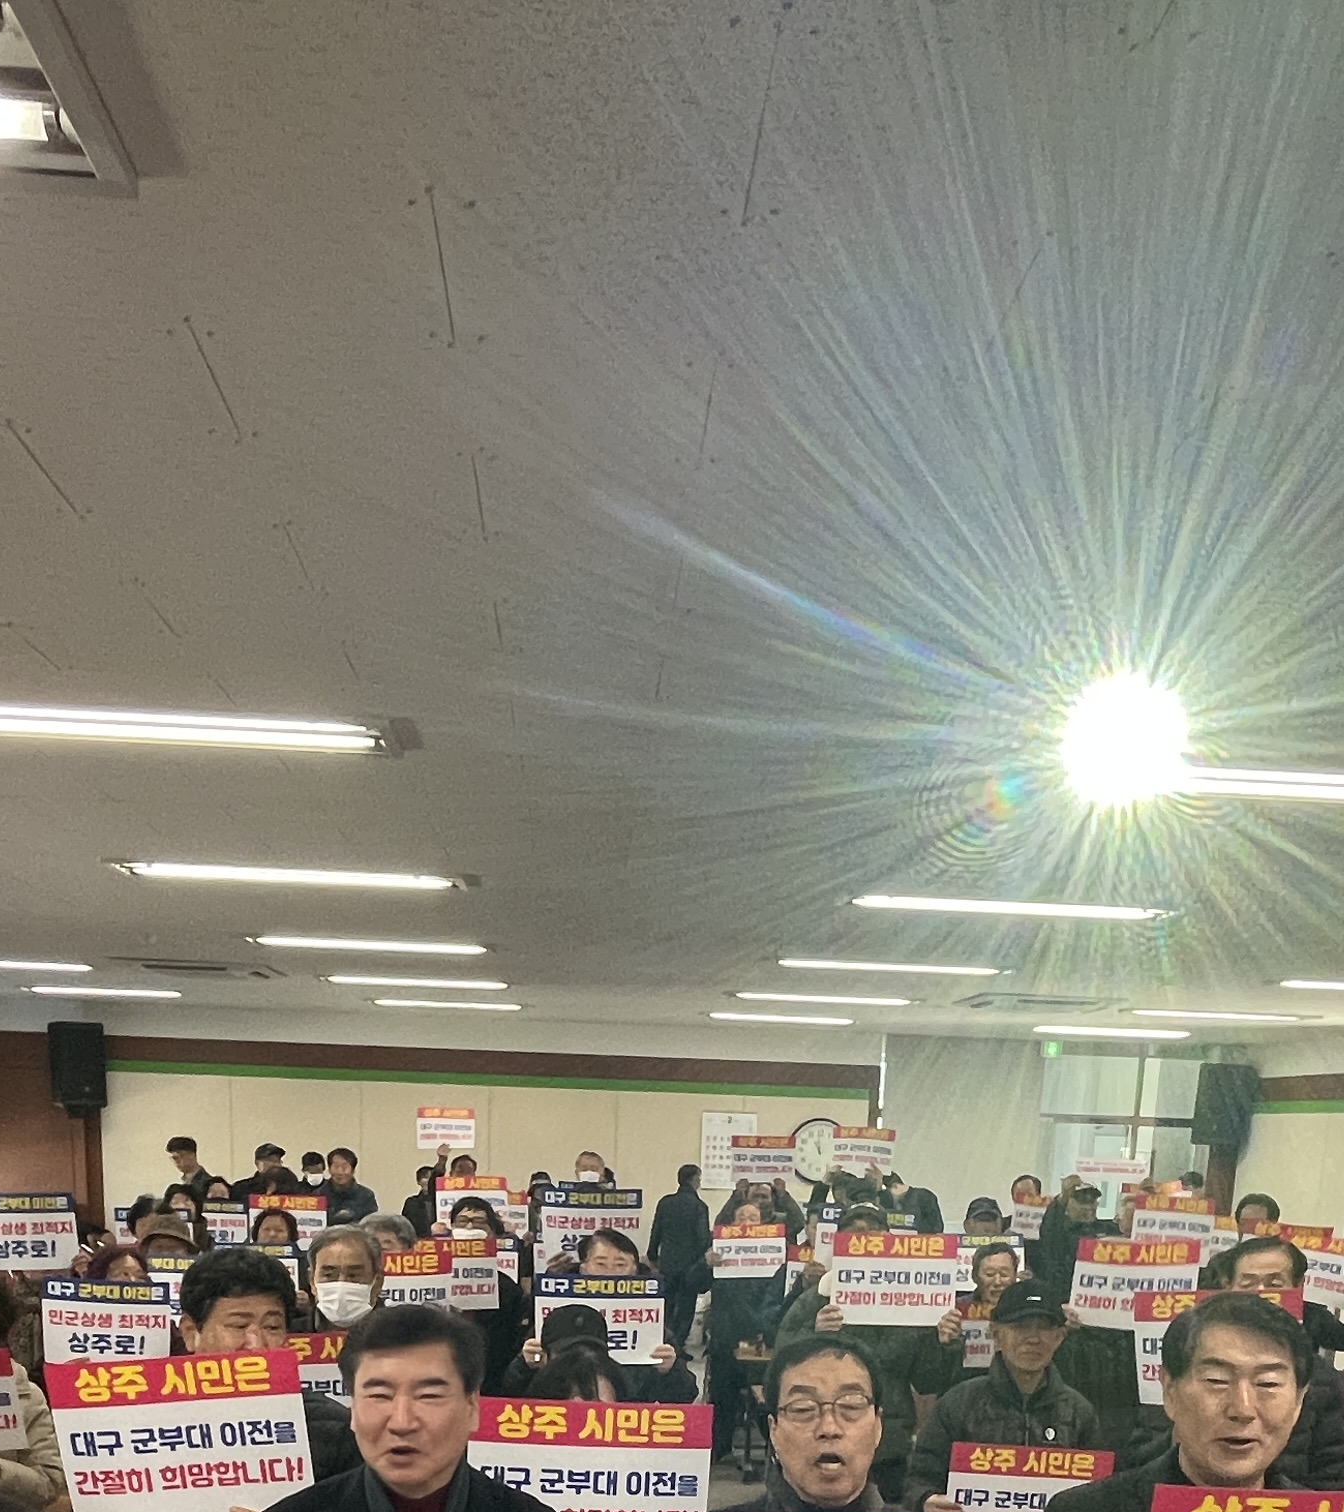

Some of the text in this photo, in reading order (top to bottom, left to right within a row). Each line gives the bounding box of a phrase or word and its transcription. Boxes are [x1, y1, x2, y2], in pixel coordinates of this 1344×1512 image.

[545, 1191, 566, 1204] 대구
[848, 1236, 945, 1257] 상주 시민은
[384, 1254, 439, 1274] 시민은
[541, 1278, 569, 1294] 대구
[573, 1279, 614, 1295] 군부대
[838, 1270, 866, 1285] 대구
[869, 1271, 911, 1286] 군부대
[47, 1280, 76, 1297] 대구
[78, 1283, 121, 1299] 군부대
[47, 1309, 167, 1330] 민군상생 최적지
[611, 1308, 660, 1324] 최적지
[67, 1332, 146, 1355] 상주로!
[74, 1356, 271, 1403] 상주 시민은
[496, 1404, 685, 1445] 상주 시민은
[70, 1419, 298, 1458] 대구 군부대 이전을
[969, 1447, 1095, 1477] 상주 시민은
[75, 1457, 304, 1496] 간절히 희망합니다!
[539, 1468, 618, 1496] 군부대
[625, 1471, 699, 1497] 이전을
[955, 1488, 1047, 1510] 대구 군부대
